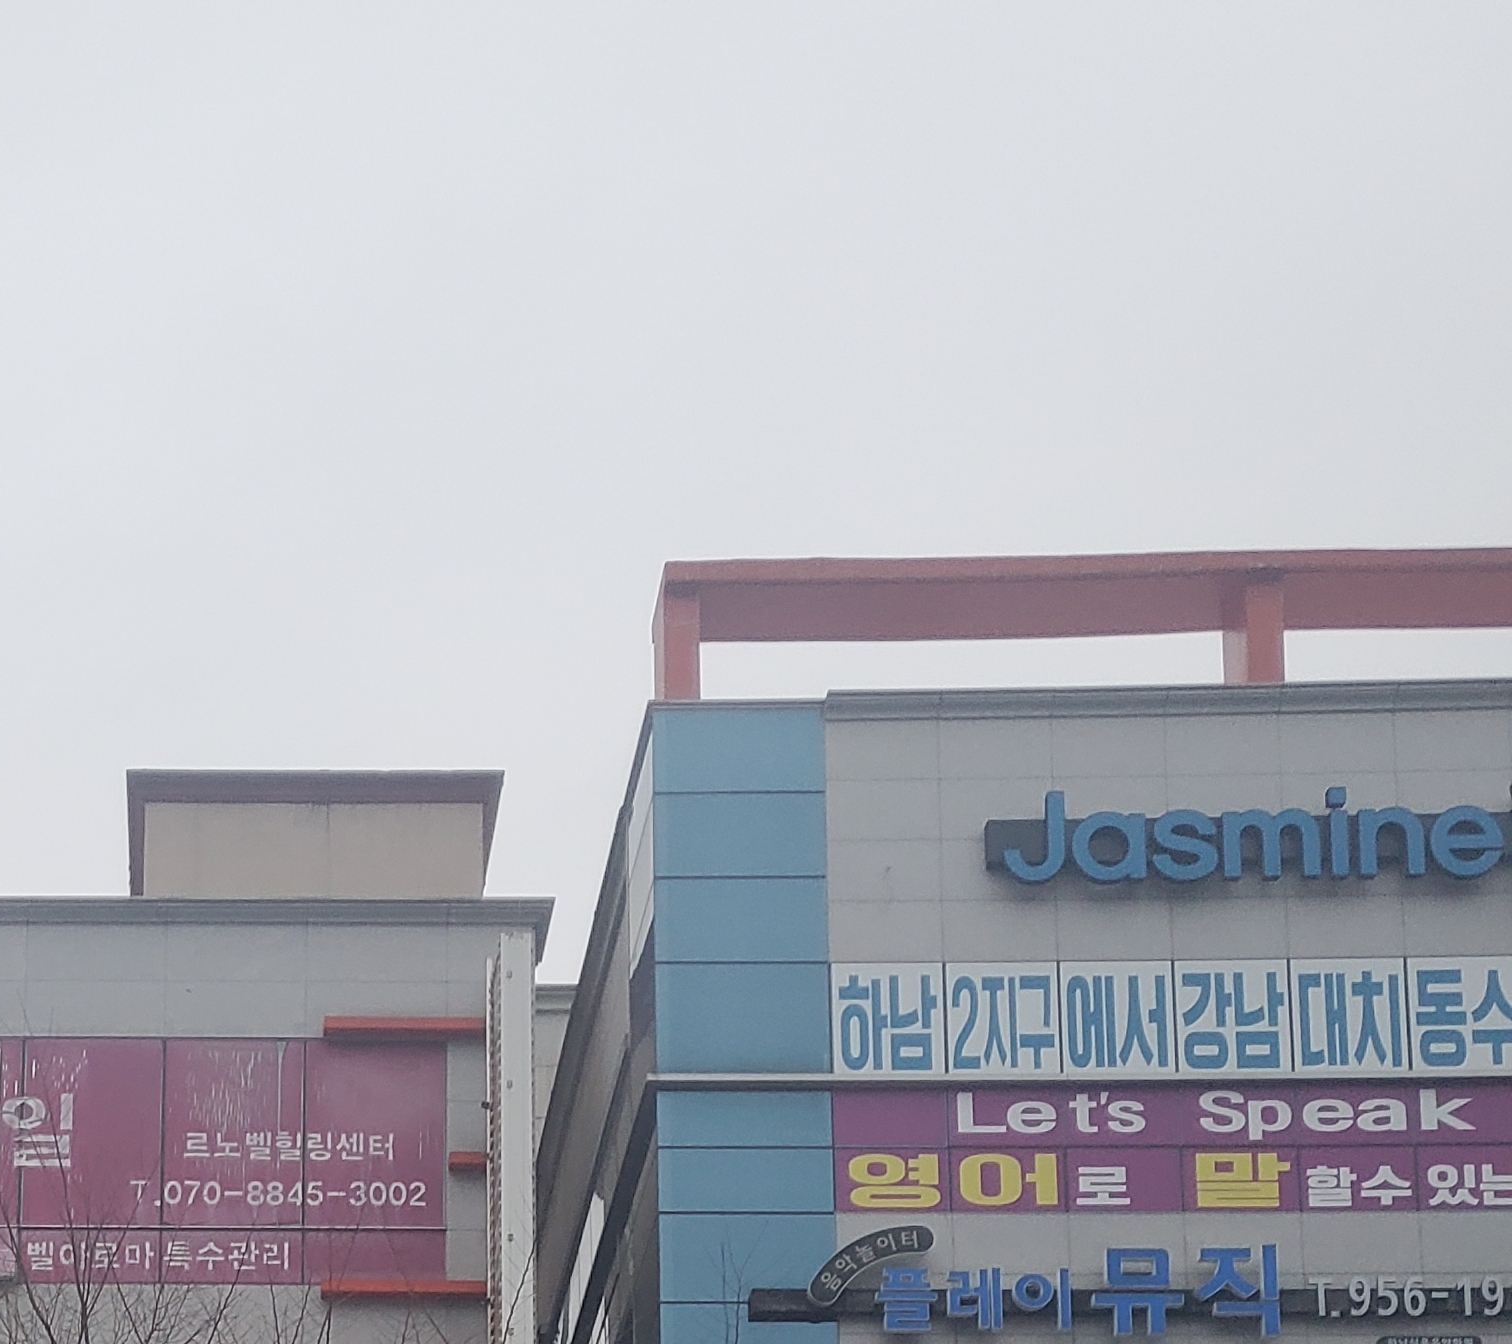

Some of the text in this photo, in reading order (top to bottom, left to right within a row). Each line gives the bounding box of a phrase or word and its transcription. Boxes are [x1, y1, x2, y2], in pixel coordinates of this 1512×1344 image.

[1003, 786, 1505, 882] Jasmine
[956, 1088, 1476, 1141] Let's Speak
[183, 1130, 396, 1161] 르노벨힐링센터
[131, 1179, 427, 1208] T.070-8845-3002
[821, 1230, 919, 1292] 음악놀이터
